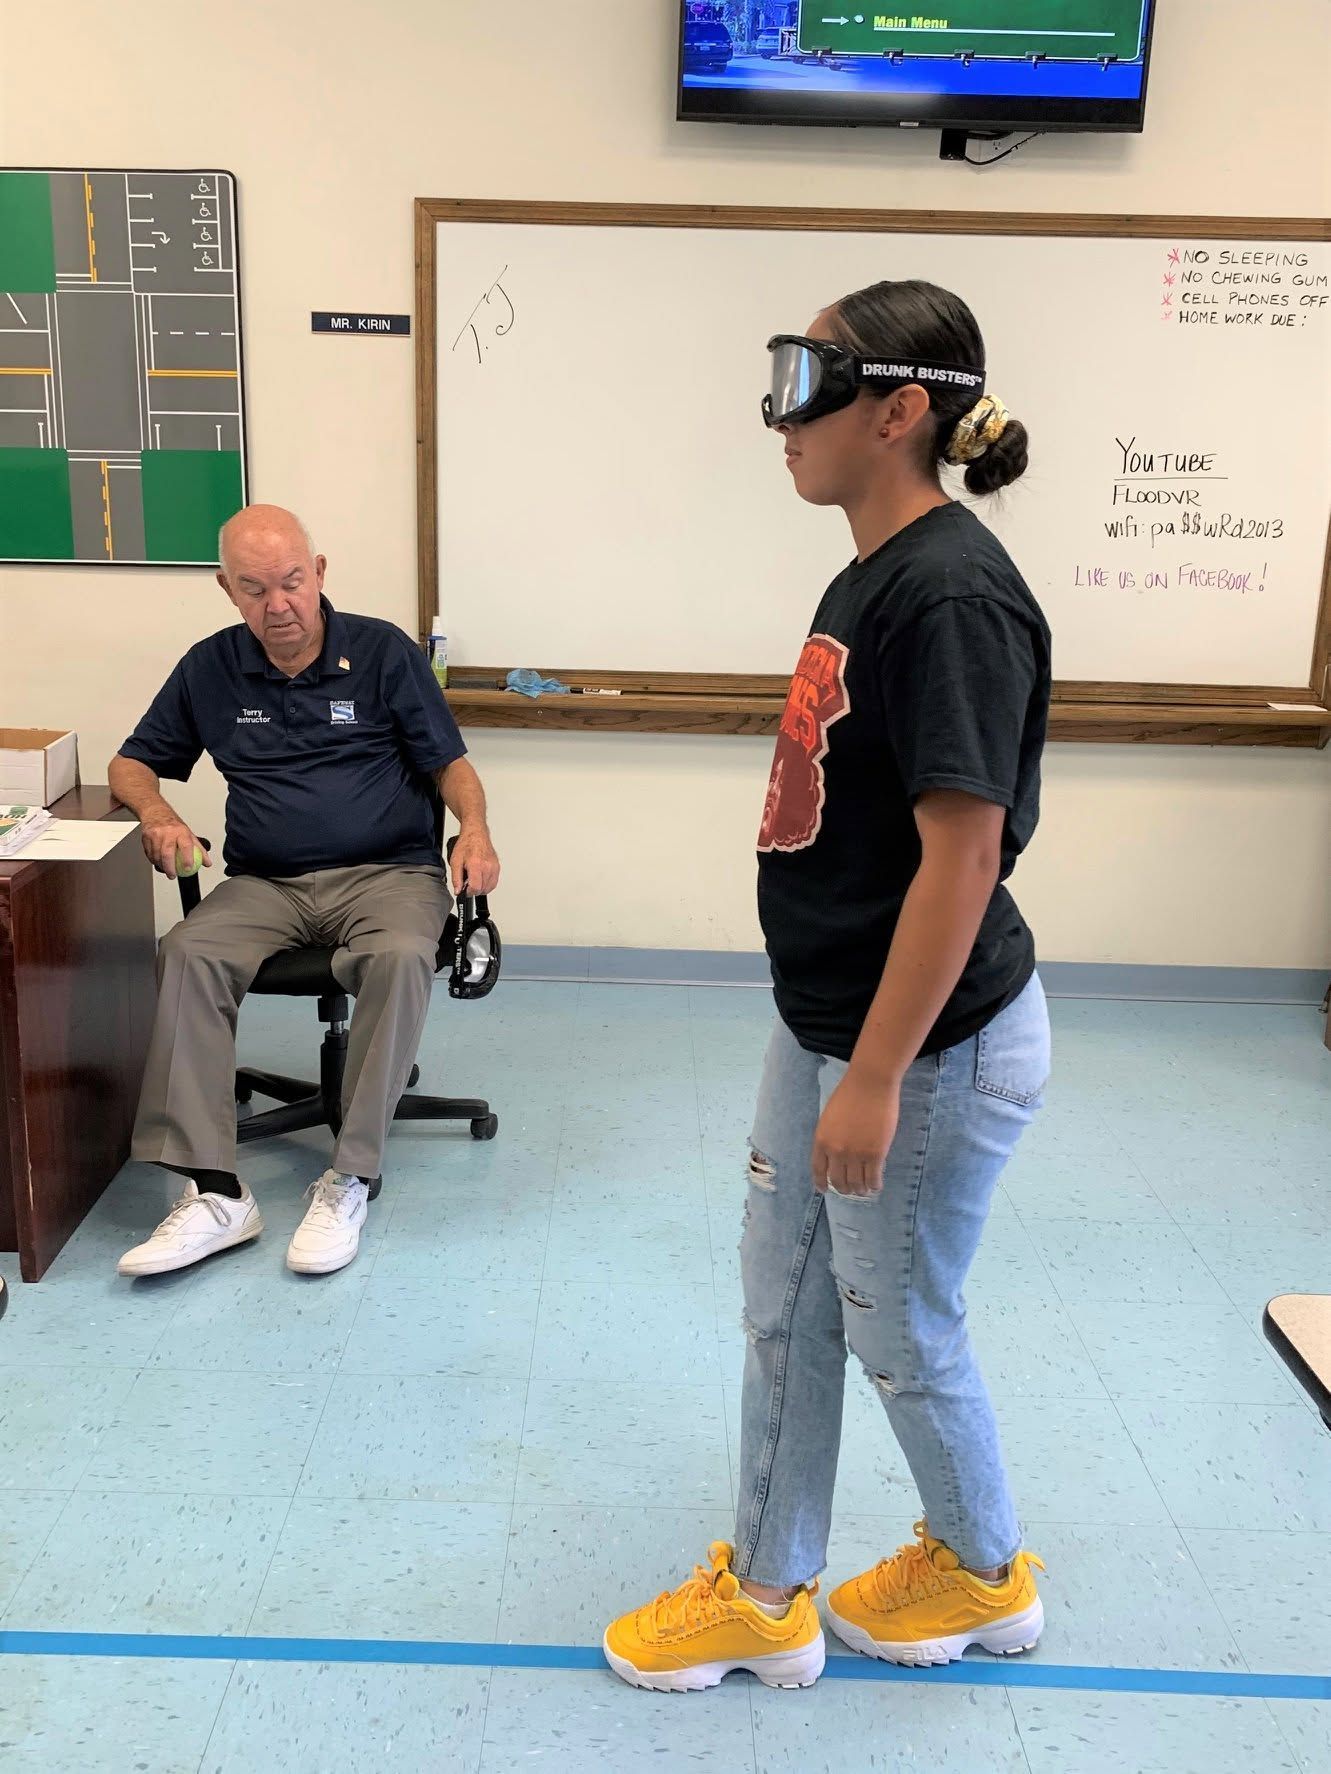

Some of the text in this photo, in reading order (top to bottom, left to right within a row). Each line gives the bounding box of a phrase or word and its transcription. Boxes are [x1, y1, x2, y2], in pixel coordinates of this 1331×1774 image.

[874, 16, 948, 29] Main Menu
[1183, 249, 1309, 267] NO SLEEPING
[1180, 270, 1329, 287] NO CHEWING GUM
[1181, 291, 1330, 308] CELL PHONES OFF
[330, 317, 391, 331] MR. KIRIN
[1179, 311, 1218, 325] HOME
[1224, 312, 1264, 325] WORK
[862, 363, 915, 378] DRUNK
[1074, 565, 1109, 587] LIKE
[1118, 571, 1136, 589] US
[1144, 572, 1168, 590] ON
[236, 716, 272, 724] Instructor
[242, 708, 263, 718] Terry
